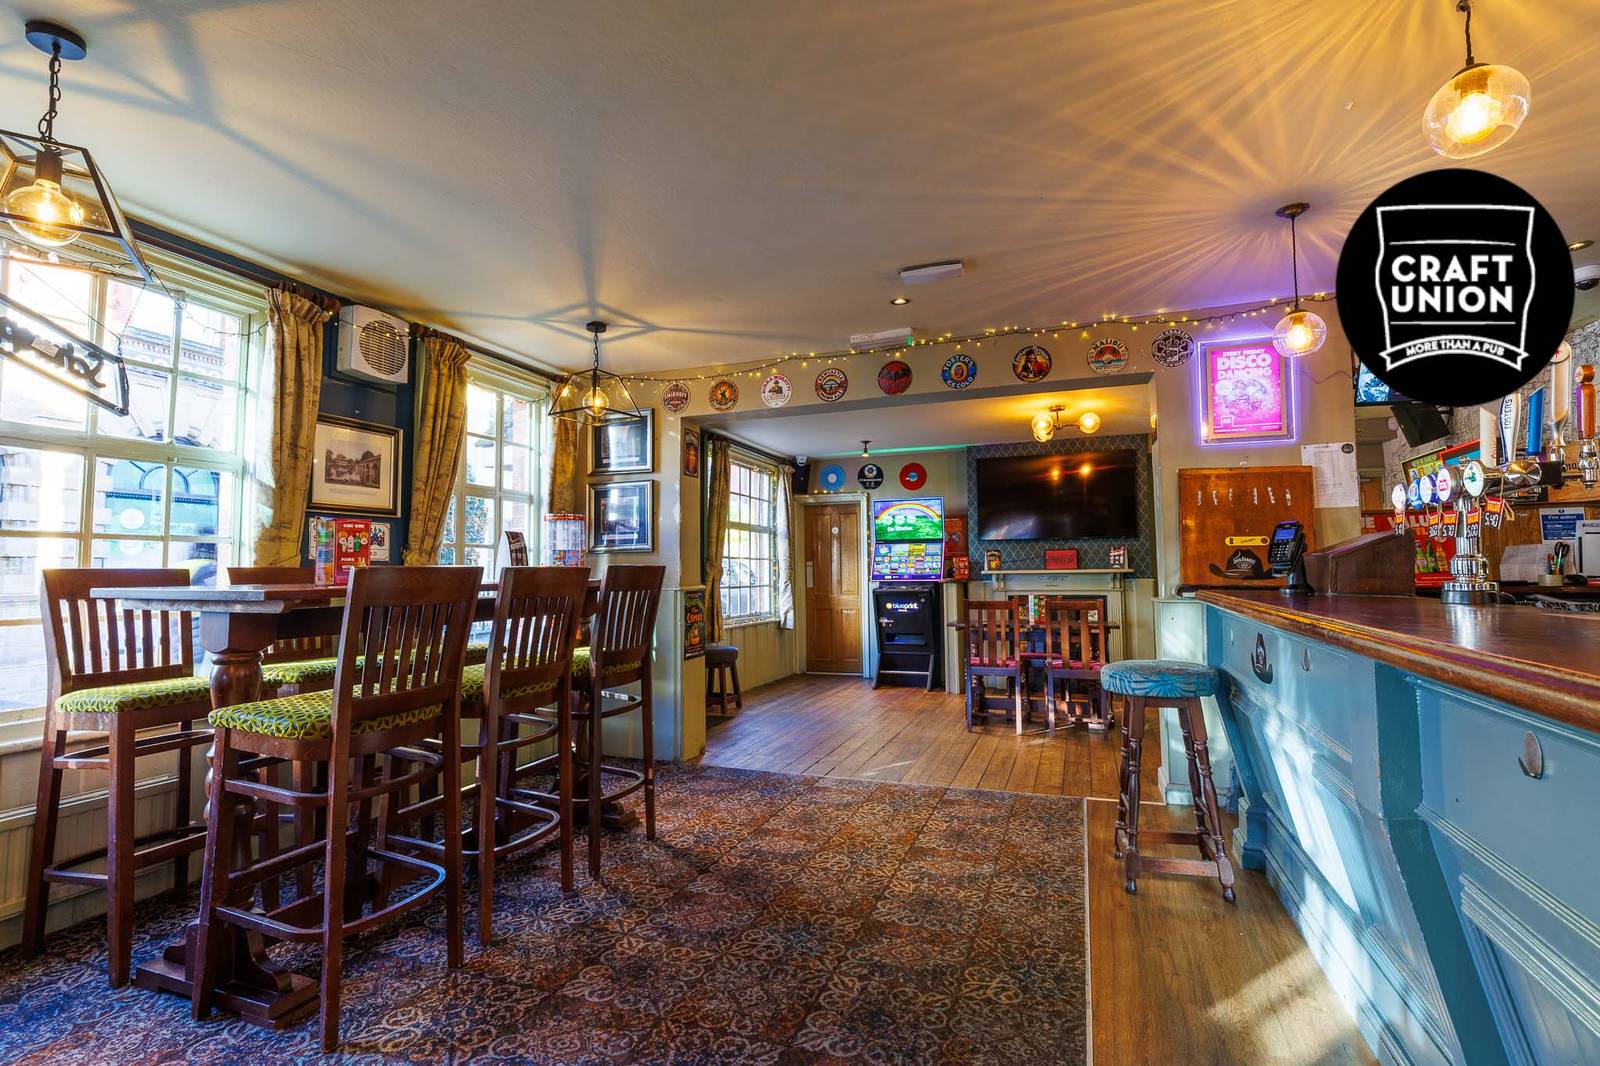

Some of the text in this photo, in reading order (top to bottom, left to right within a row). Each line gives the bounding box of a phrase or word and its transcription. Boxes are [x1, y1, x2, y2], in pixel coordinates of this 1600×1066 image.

[1092, 339, 1124, 351] MALIBU
[1216, 353, 1273, 370] DISCO
[1216, 366, 1273, 381] DANCING
[956, 376, 973, 389] COLD
